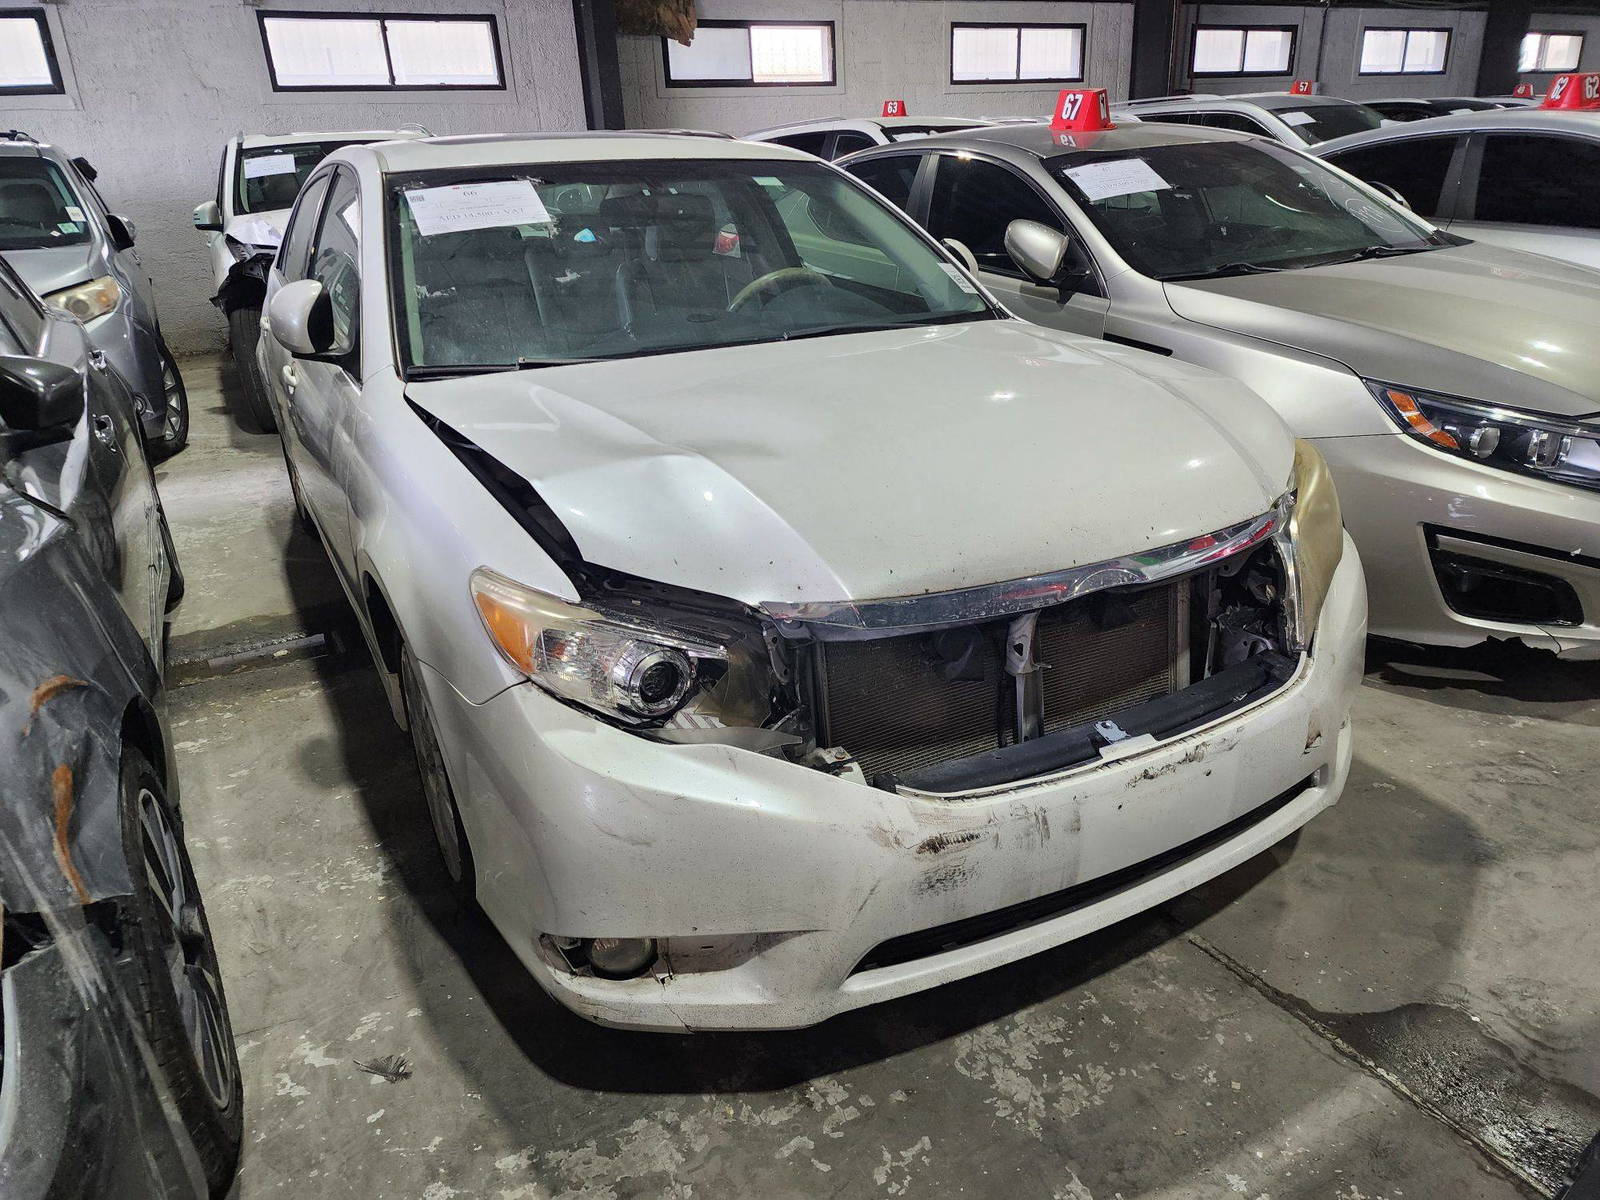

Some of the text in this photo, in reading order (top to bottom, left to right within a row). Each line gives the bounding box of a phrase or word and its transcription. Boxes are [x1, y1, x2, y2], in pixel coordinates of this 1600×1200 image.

[1300, 81, 1309, 92] 57
[1585, 76, 1600, 99] 62
[888, 101, 898, 114] 63
[1061, 93, 1084, 120] 67
